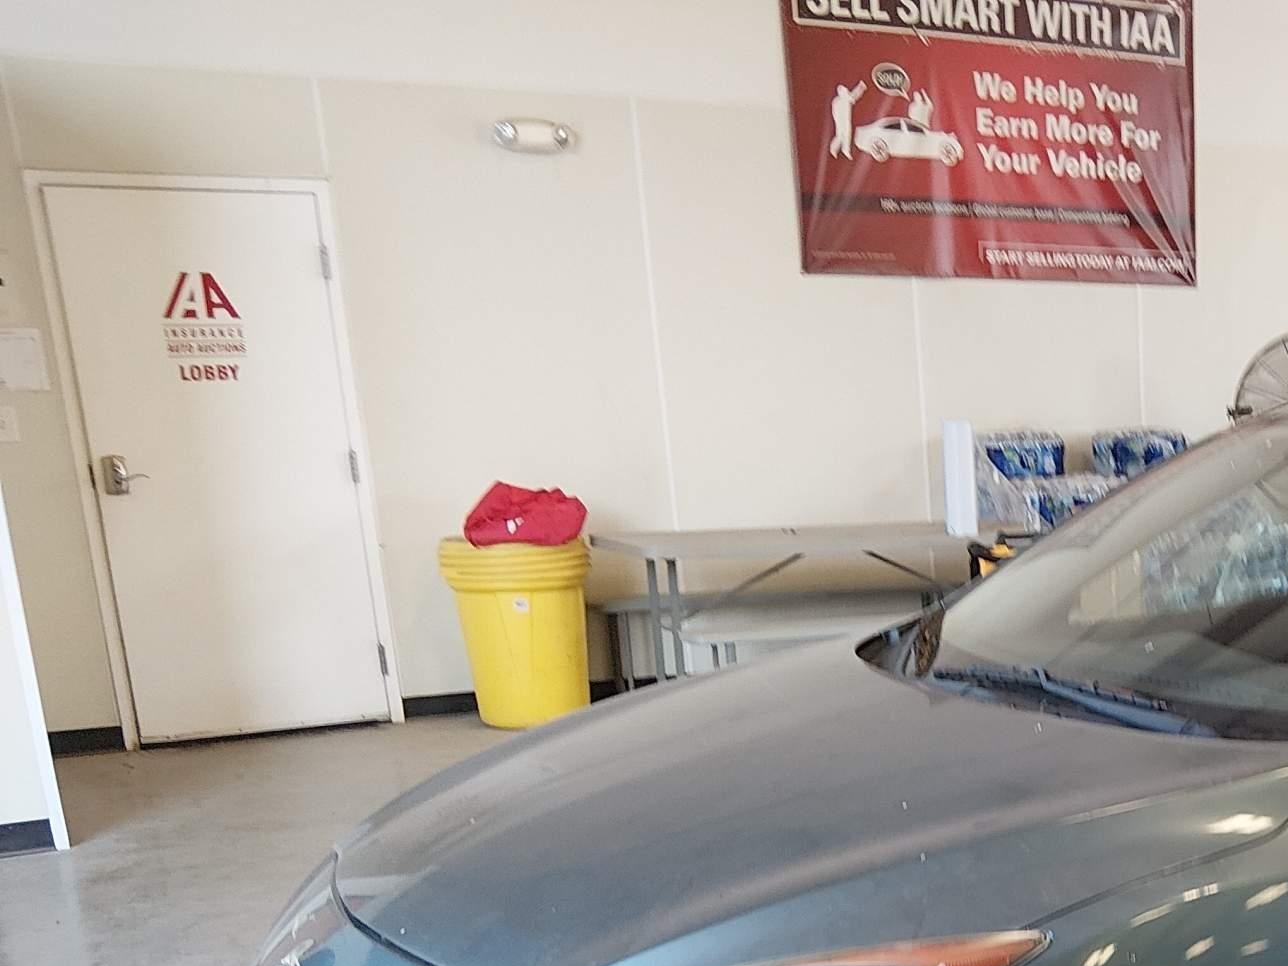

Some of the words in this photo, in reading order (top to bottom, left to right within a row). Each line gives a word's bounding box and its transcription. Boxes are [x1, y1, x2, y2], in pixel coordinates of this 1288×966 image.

[897, 0, 1020, 36] SMART
[1025, 0, 1113, 47] WITH
[1120, 8, 1176, 55] IAA
[973, 70, 1017, 103] We
[1023, 75, 1085, 114] Help
[1090, 82, 1139, 115] You
[975, 107, 1039, 140] Earn
[1045, 112, 1114, 147] More
[1120, 119, 1161, 151] For
[976, 142, 1041, 175] Your
[1046, 147, 1142, 184] Vehicle
[985, 249, 1025, 266] START
[1026, 250, 1075, 268] SELLING
[1075, 253, 1113, 270] TODAY
[163, 327, 244, 338] INSURANCE
[179, 364, 240, 381] LOBBY
